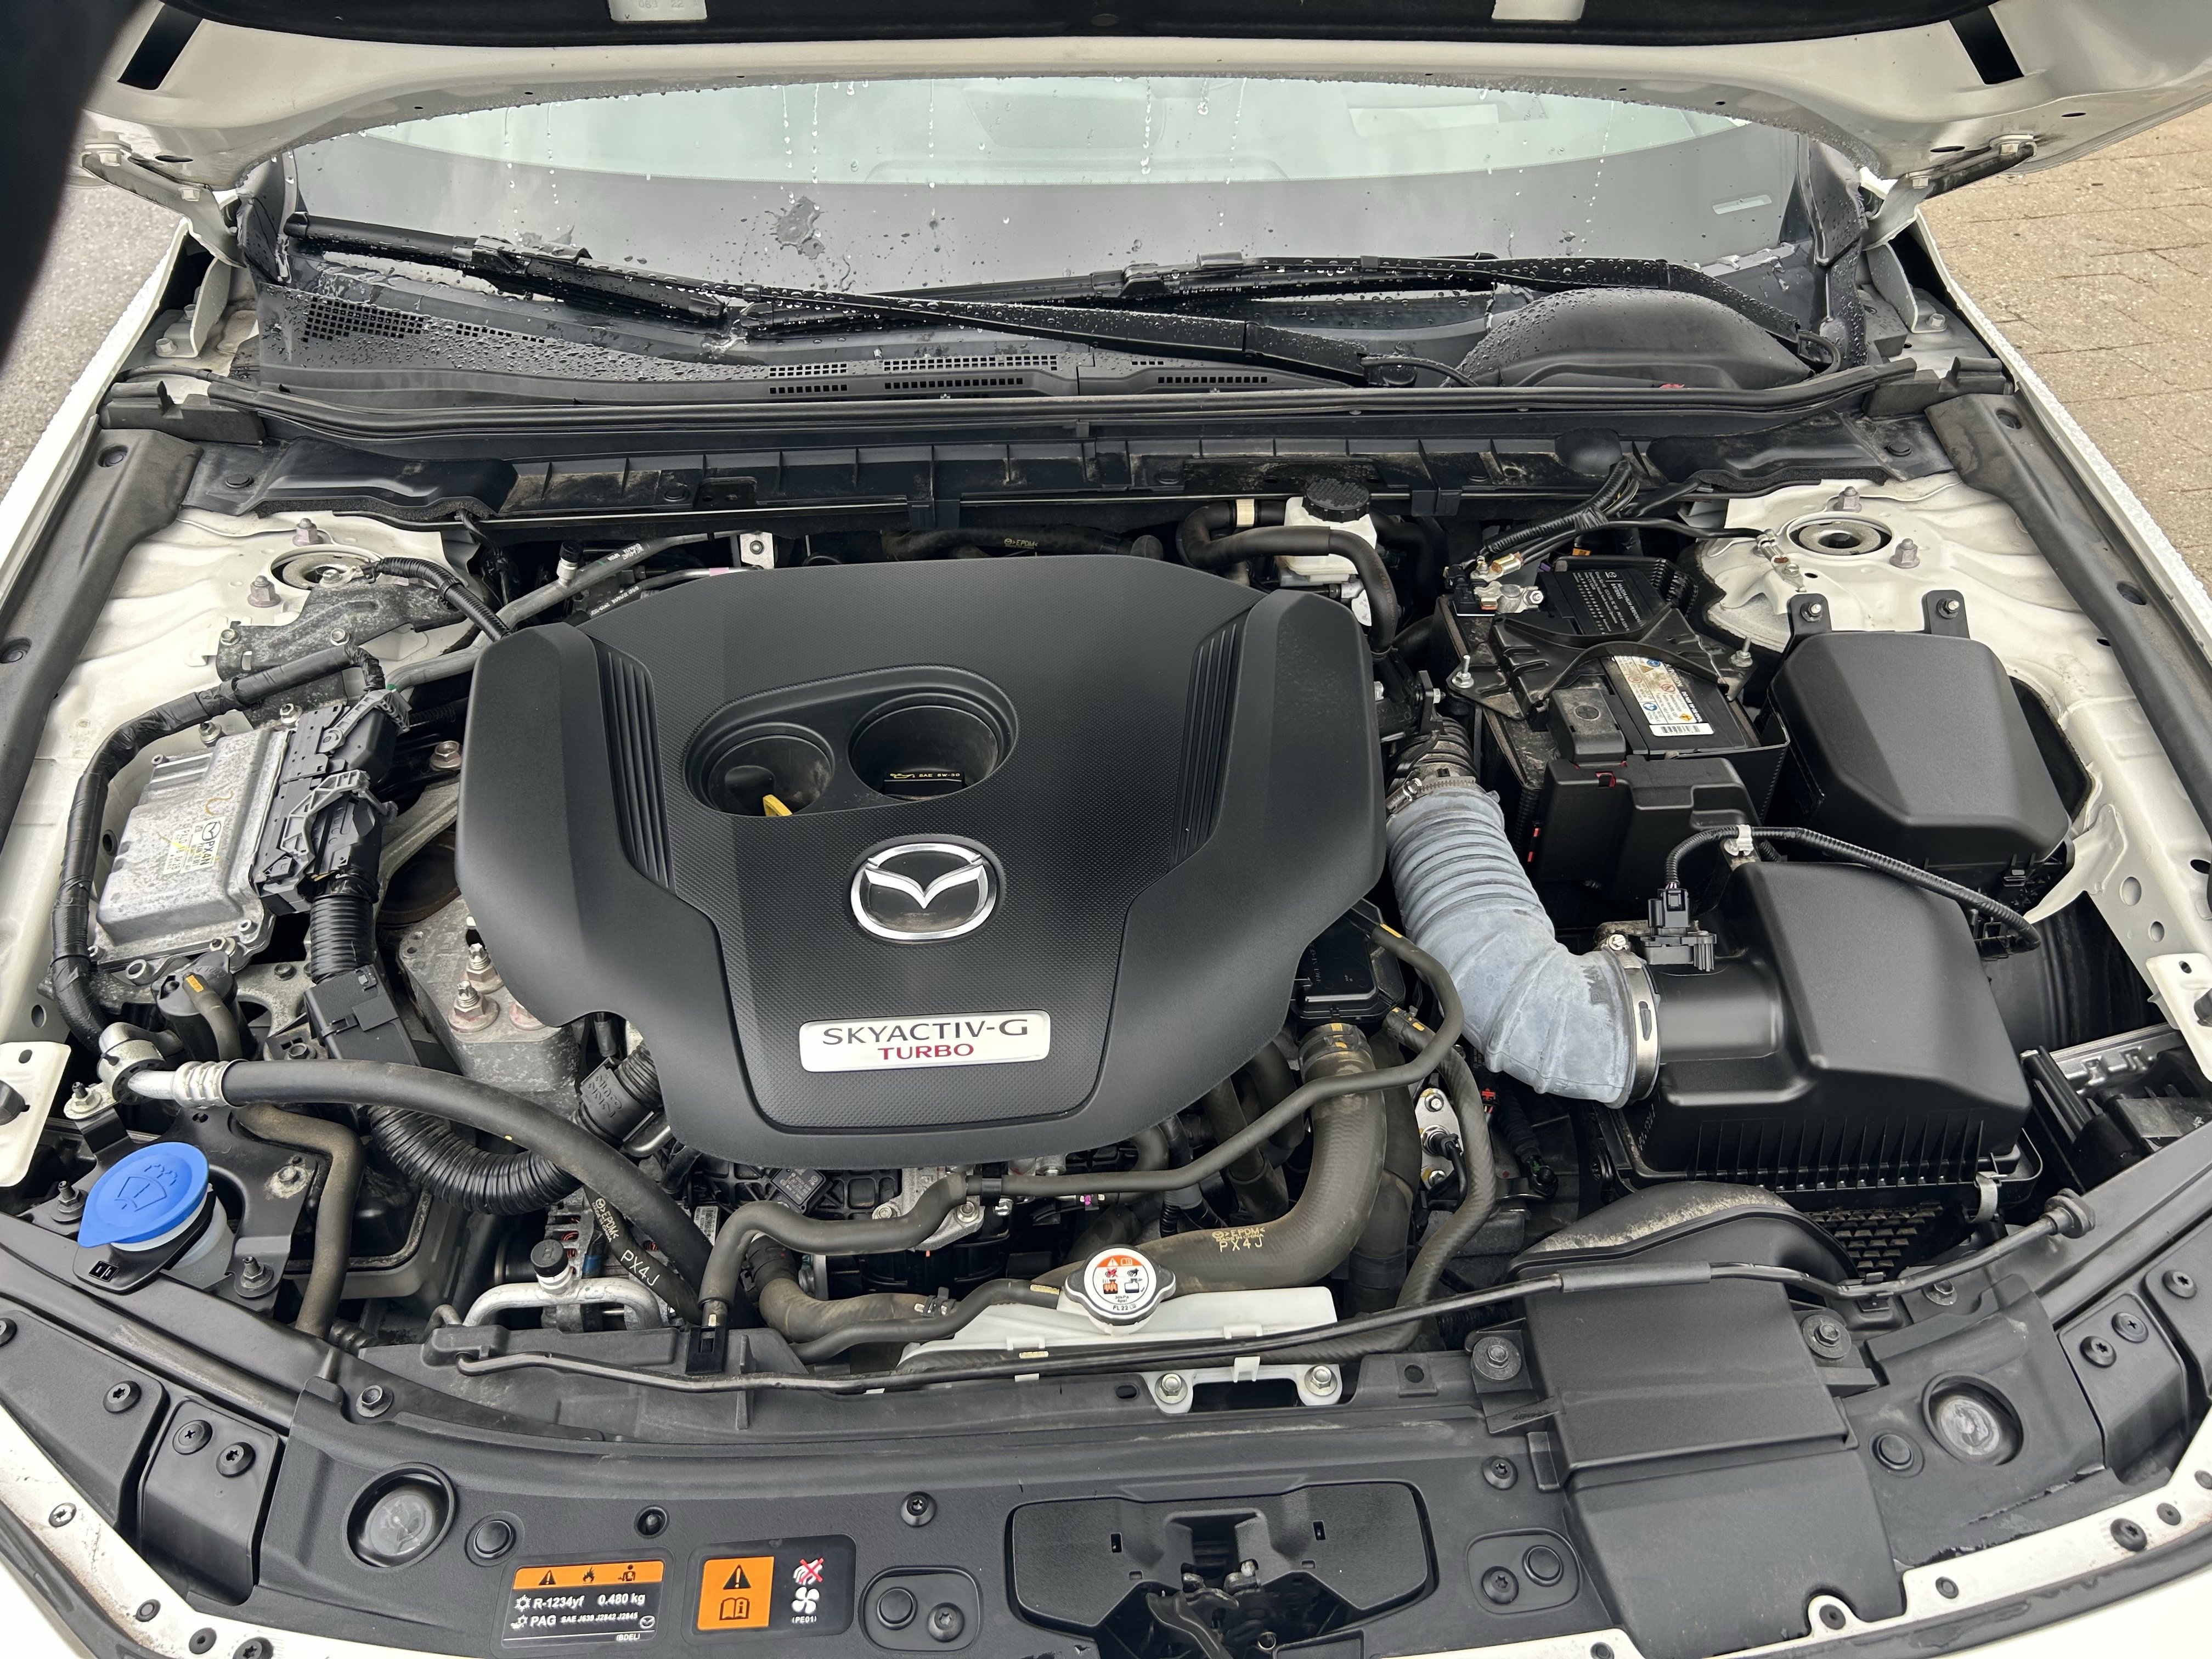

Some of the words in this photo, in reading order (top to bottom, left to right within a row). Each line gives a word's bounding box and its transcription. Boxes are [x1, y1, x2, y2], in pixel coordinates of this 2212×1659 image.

[822, 1019, 1028, 1045] SKYACTIV-G
[878, 1043, 974, 1060] TURBO
[1224, 1227, 1265, 1237] >EPDM<
[1220, 1237, 1262, 1252] PX4J
[620, 1250, 660, 1286] PX4J
[533, 1595, 584, 1610] R-1234yf
[598, 1595, 628, 1606] 0.480
[631, 1593, 646, 1606] kg
[530, 1615, 557, 1627] PAG
[792, 1616, 817, 1624] (PE01)
[616, 1633, 640, 1641] (BDEL)
